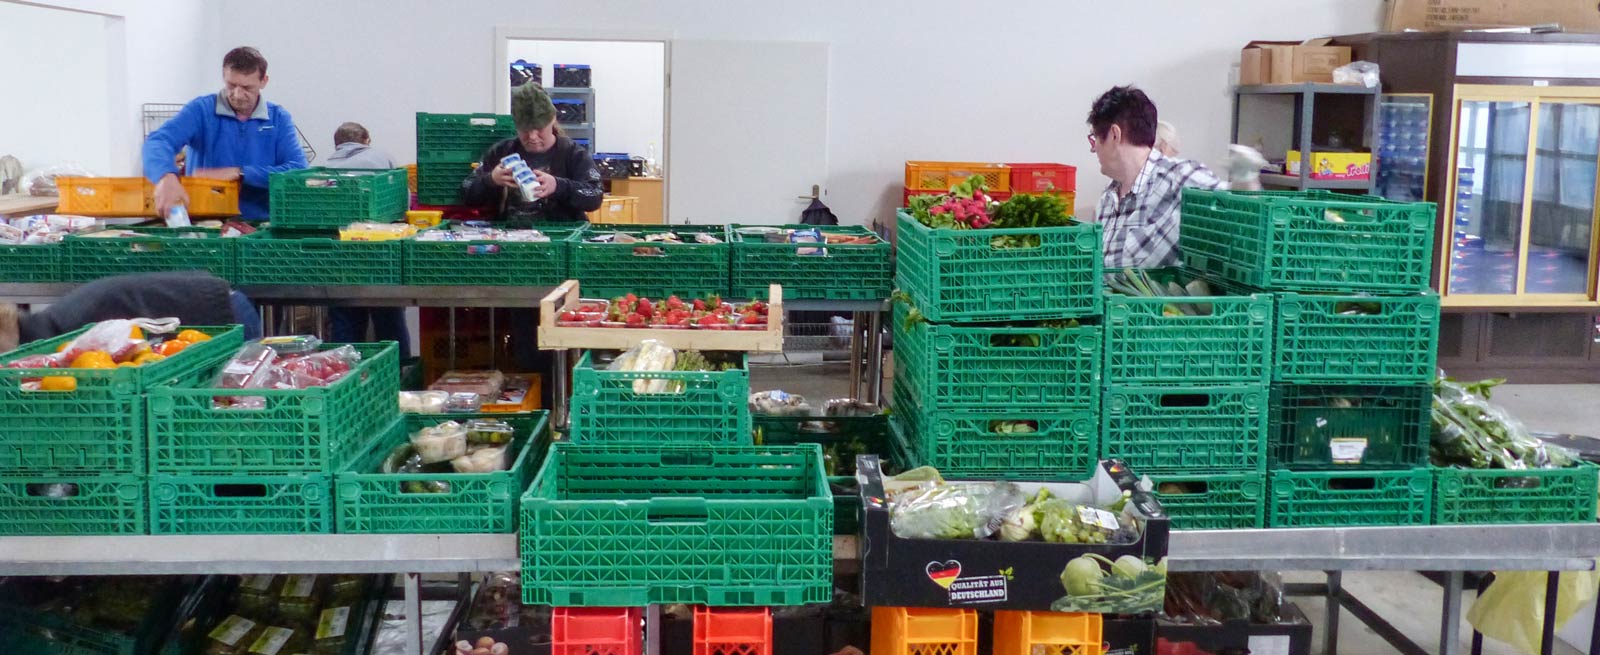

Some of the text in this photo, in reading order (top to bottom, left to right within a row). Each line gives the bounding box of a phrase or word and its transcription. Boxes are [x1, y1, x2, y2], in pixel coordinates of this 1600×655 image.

[1346, 163, 1369, 176] Trolli
[951, 579, 1003, 590] QUALITÄT AUS
[951, 589, 1004, 600] DEUTSCHLAND
